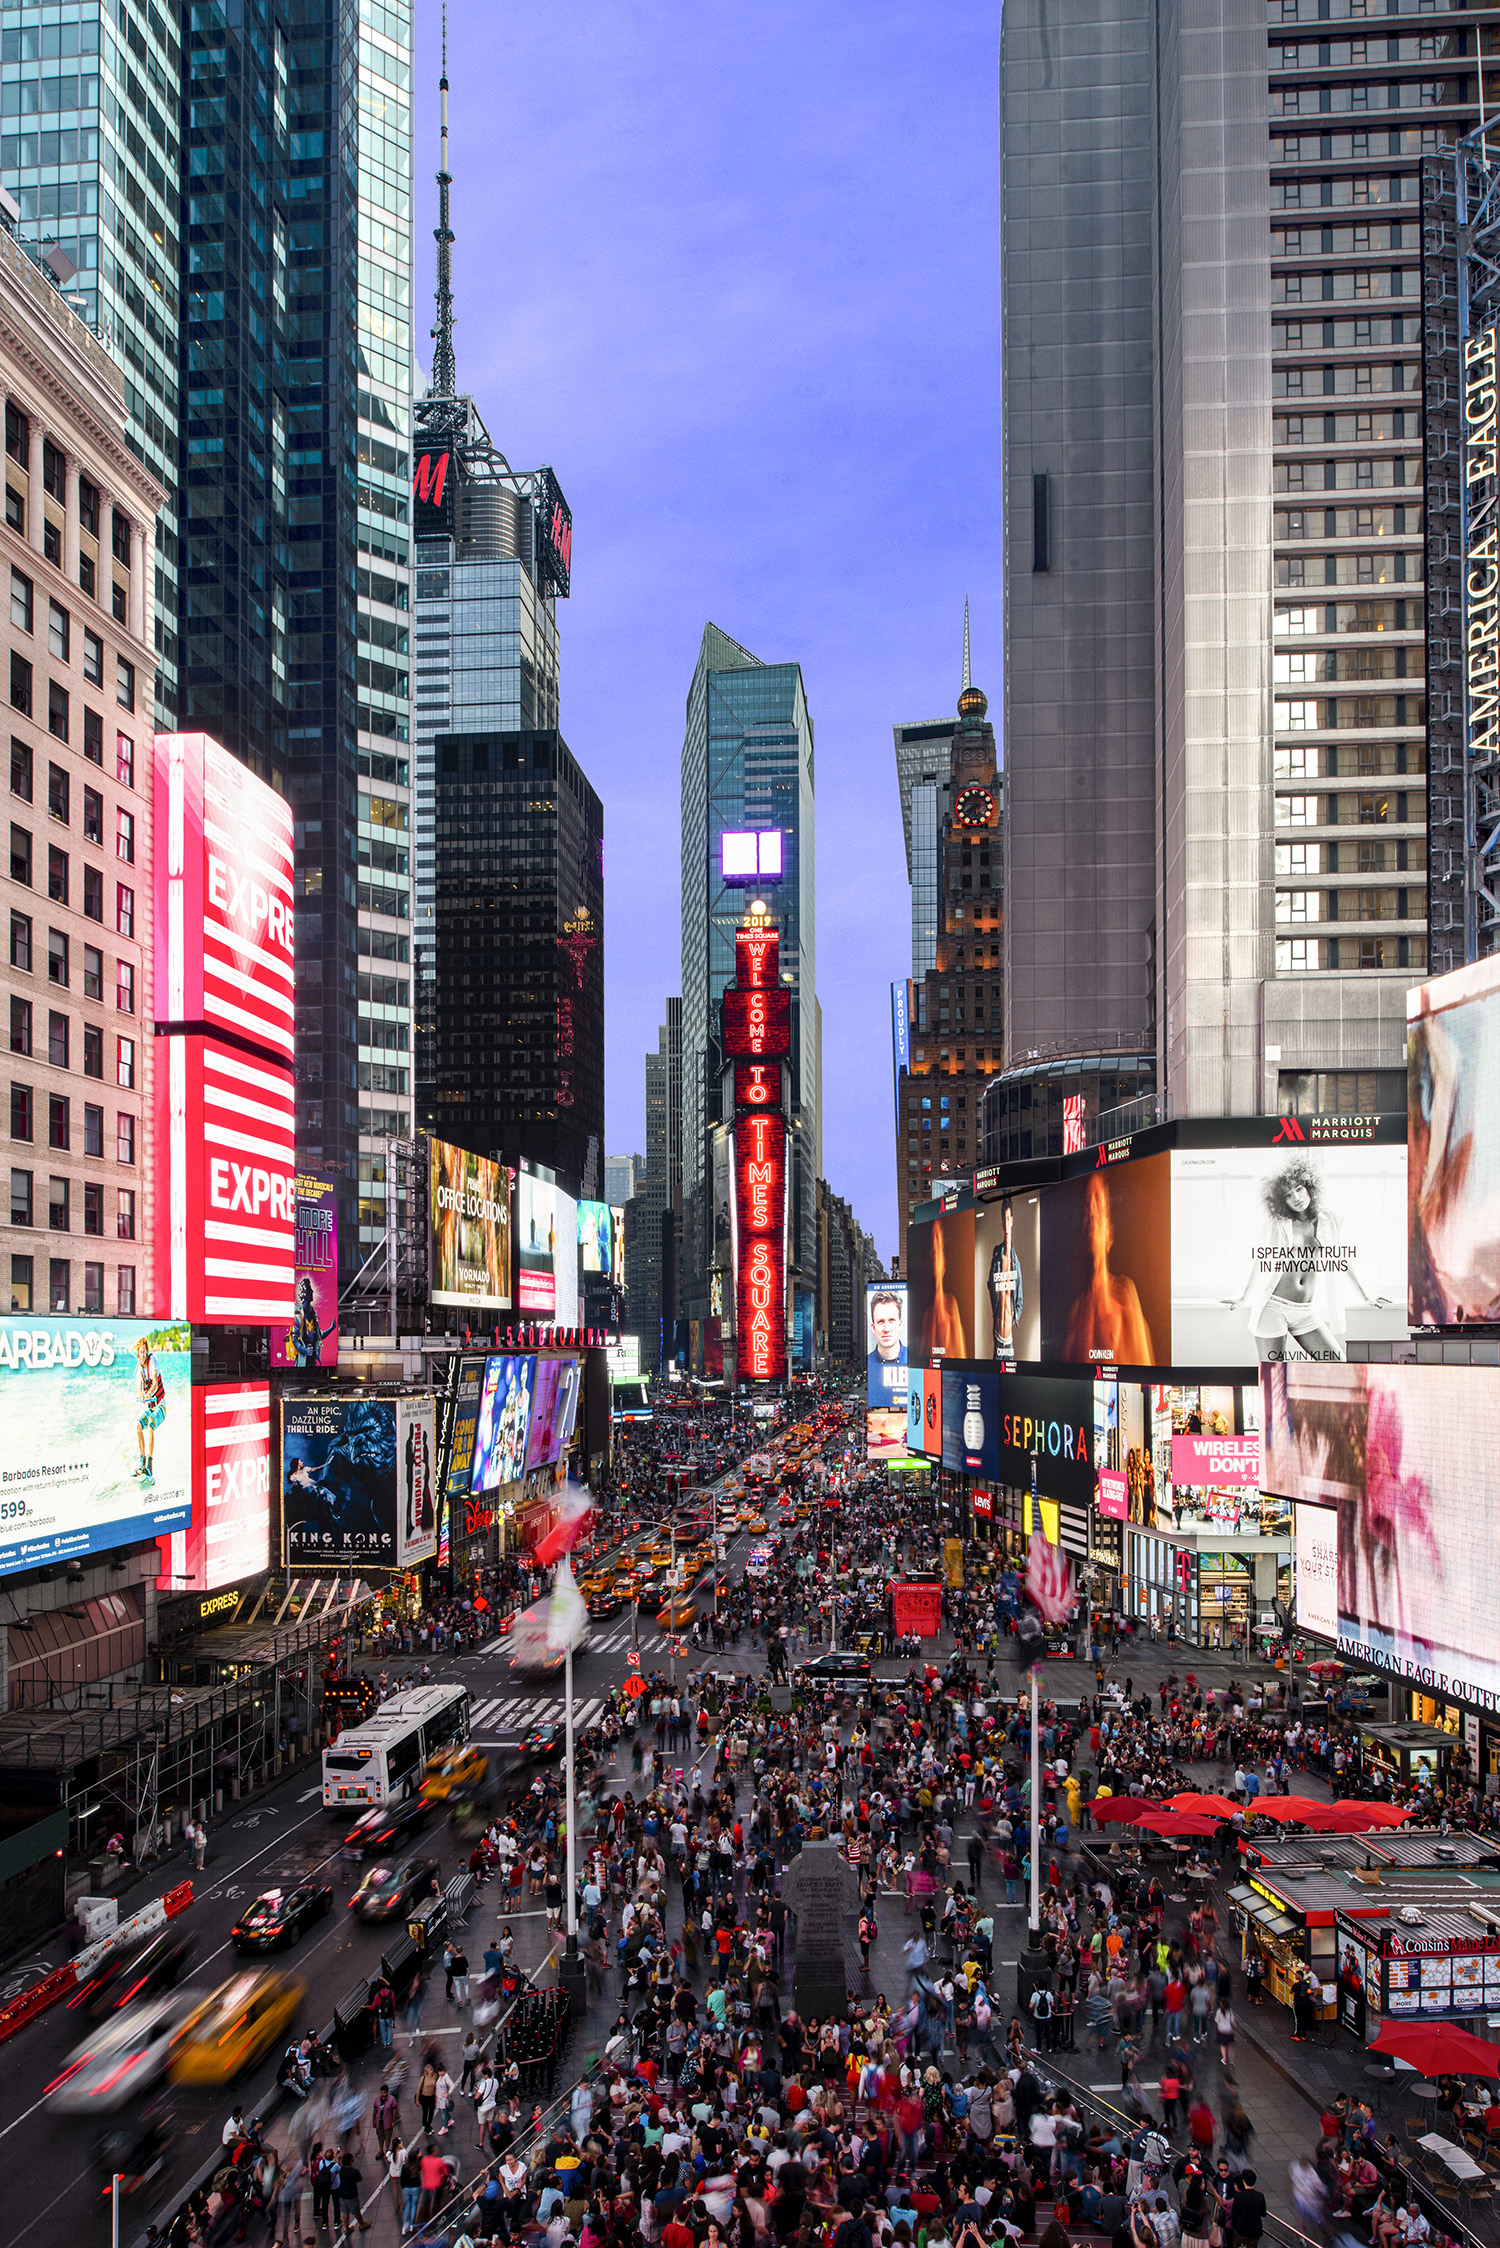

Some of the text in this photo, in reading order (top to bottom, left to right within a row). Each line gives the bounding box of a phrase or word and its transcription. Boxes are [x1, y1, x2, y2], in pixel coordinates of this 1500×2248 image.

[1465, 327, 1499, 755] AMERICAN EAGLE
[743, 916, 772, 927] 2019
[897, 990, 905, 1055] PROUDLY
[1312, 1116, 1382, 1127] MARRIOTT
[1312, 1128, 1374, 1138] MARQUIS
[1108, 1136, 1132, 1151] MARRIOTT
[748, 943, 772, 1374] WELCOME TO TIMES SQUARE
[1108, 1148, 1130, 1161] MARQUIS
[976, 1167, 1000, 1180] MARRIOTT
[313, 1181, 334, 1192] MUSICALS
[976, 1178, 997, 1190] MARQUIS
[437, 1185, 508, 1225] OFFICE LOCATIONS
[299, 1206, 333, 1232] MORE
[1251, 1245, 1357, 1259] I SPEAK MY TRUTH
[459, 1267, 490, 1284] VORNADO
[1260, 1260, 1348, 1273] IN #MYCALVINS
[494, 1326, 609, 1346] 1540 BROADWAY
[1267, 1350, 1341, 1362] CALVIN KLEIN
[882, 1366, 908, 1387] KLE
[287, 1425, 314, 1433] THRILL
[291, 1415, 332, 1424] DAZZLING
[455, 1418, 476, 1436] COME
[414, 1423, 422, 1468] PRETTY
[452, 1435, 475, 1455] FROM
[1003, 1413, 1088, 1462] SEPHORA
[450, 1451, 473, 1472] AWAY
[2, 1463, 67, 1482] Barbados Resort
[205, 1454, 270, 1507] EXPR
[0, 1486, 22, 1496] acation
[22, 1483, 34, 1492] with
[34, 1481, 51, 1490] return
[51, 1478, 67, 1488] flights
[67, 1476, 81, 1485] from
[1, 1499, 26, 1520] 599
[414, 1476, 422, 1527] WOMAN
[463, 1500, 493, 1535] Disney
[290, 1531, 333, 1543] KING
[343, 1532, 392, 1544] KONG
[1177, 1551, 1191, 1592] T
[1299, 1558, 1323, 1575] YOUR
[200, 1590, 239, 1618] EXPRESS
[1307, 1611, 1330, 1625] AMERICAN
[1336, 1636, 1402, 1675] AMERICAN
[1405, 1659, 1449, 1694] EAGLE
[1405, 1937, 1450, 1953] Cousins
[1450, 1936, 1484, 1950] Maine
